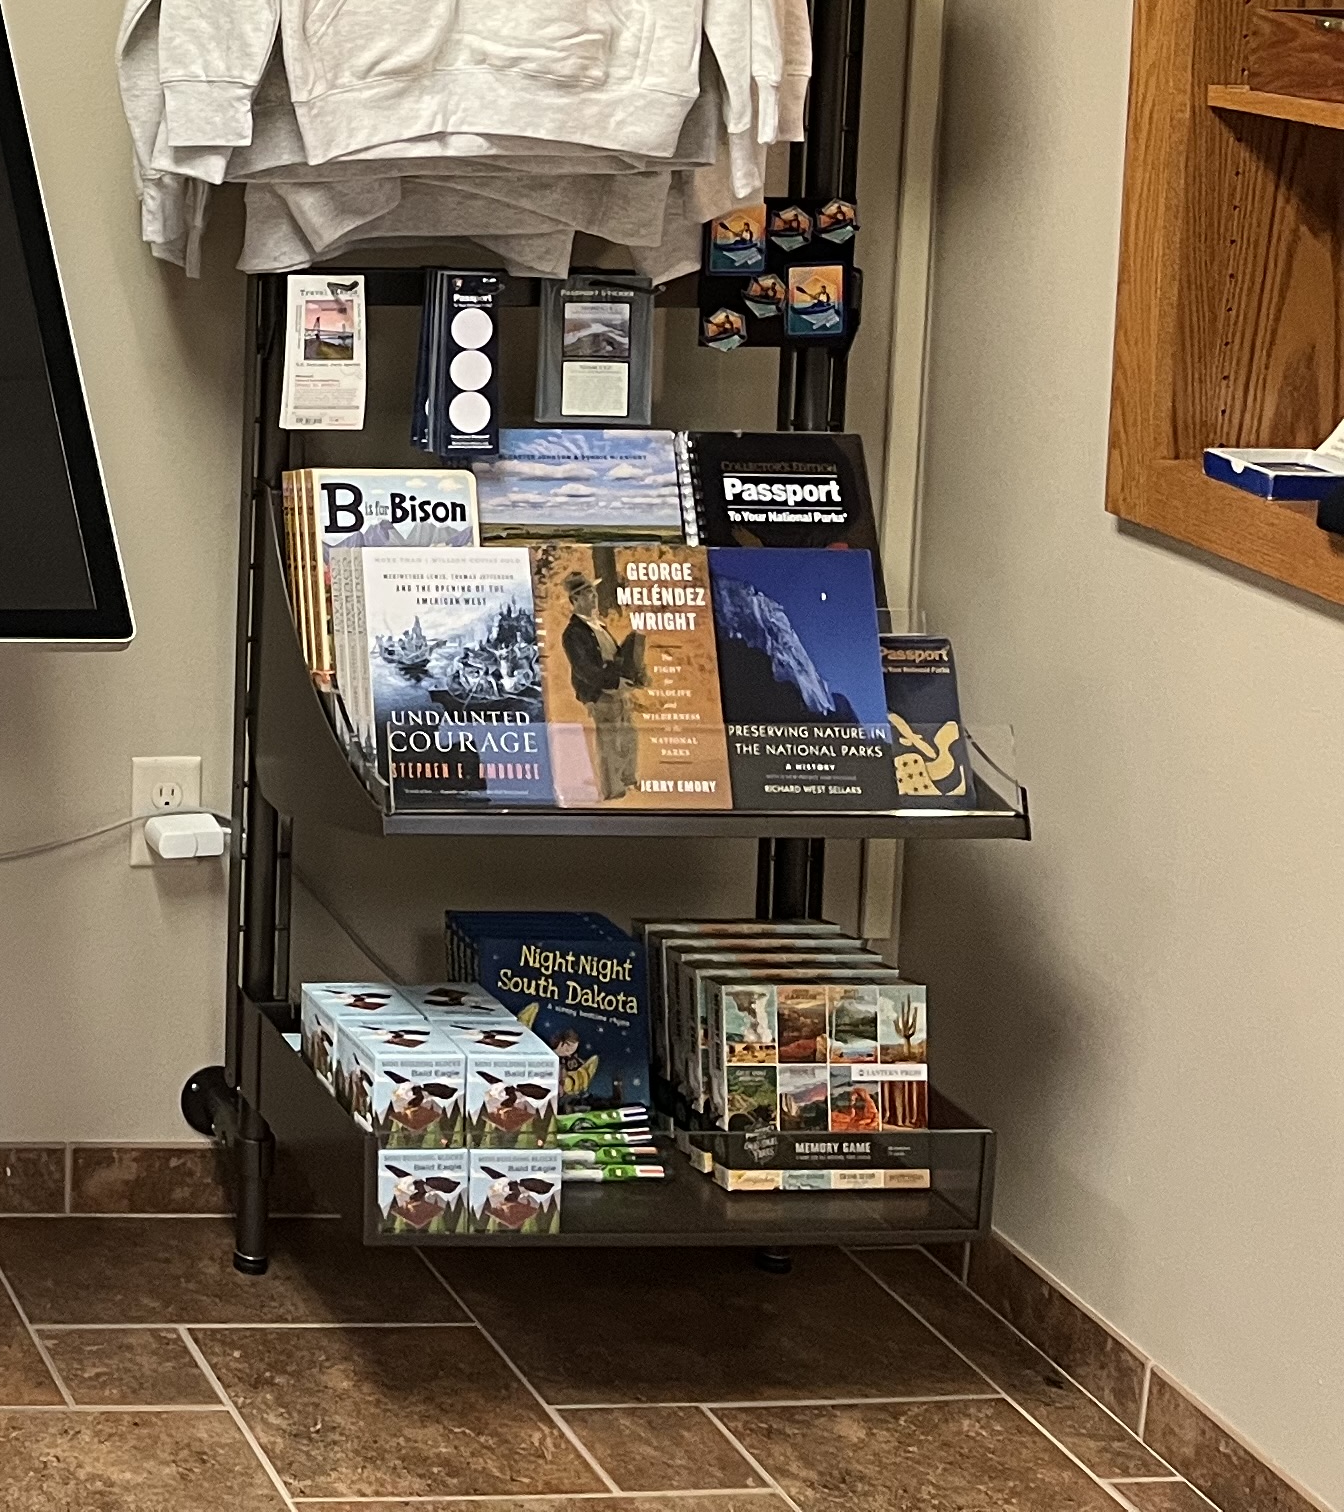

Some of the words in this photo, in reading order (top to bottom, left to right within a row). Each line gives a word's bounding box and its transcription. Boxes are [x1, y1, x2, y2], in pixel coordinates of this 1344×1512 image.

[299, 289, 327, 297] Travel
[453, 293, 492, 306] Passport
[792, 462, 838, 473] EDITION
[722, 477, 842, 506] Passport
[321, 482, 365, 534] B
[365, 500, 373, 517] is
[374, 500, 390, 518] for
[389, 492, 467, 525] Bison
[727, 510, 743, 523] To
[742, 510, 767, 523] Your
[768, 510, 813, 524] National
[626, 562, 693, 582] GEORGE
[395, 585, 412, 593] AND
[416, 585, 431, 593] THE
[435, 585, 472, 593] OPENING
[475, 585, 485, 593] OF
[488, 585, 505, 593] THE
[616, 584, 707, 607] MELÉNDEZ
[416, 597, 461, 606] AMERICAN
[463, 597, 487, 606] WEST
[629, 611, 697, 632] WRIGHT
[879, 645, 949, 664] Passport
[653, 665, 682, 675] FIGHT
[647, 689, 693, 699] WILDLIFE
[390, 710, 531, 727] UNDAUNTED
[642, 713, 701, 722] WILDERNESS
[728, 725, 809, 739] PRESERVING
[813, 726, 867, 739] NATURE
[870, 727, 886, 739] IN
[388, 730, 539, 754] COURAGE
[650, 736, 699, 746] NATIONAL
[661, 748, 691, 757] PARKS
[734, 743, 761, 756] THE
[765, 744, 837, 757] NATIONAL
[841, 746, 883, 759] PARKS
[390, 761, 450, 780] STEPHEN
[478, 762, 540, 780] AMBROSE
[785, 763, 792, 771] A
[795, 763, 836, 771] HISTORY
[640, 779, 675, 793] JERRY
[677, 780, 717, 794] EMORY
[764, 784, 802, 794] RICHARD
[802, 785, 826, 795] WEST
[827, 785, 862, 795] SELLARS
[519, 944, 576, 976] Night
[578, 957, 634, 983] Night
[497, 968, 559, 1000] South
[564, 980, 638, 1015] Dakota
[411, 1069, 432, 1078] Bald
[434, 1069, 461, 1079] Eagle
[504, 1069, 526, 1078] Bald
[527, 1069, 554, 1079] Eagle
[865, 1068, 899, 1077] LANTERN
[794, 1142, 840, 1155] MEMORY
[842, 1142, 872, 1155] GAME
